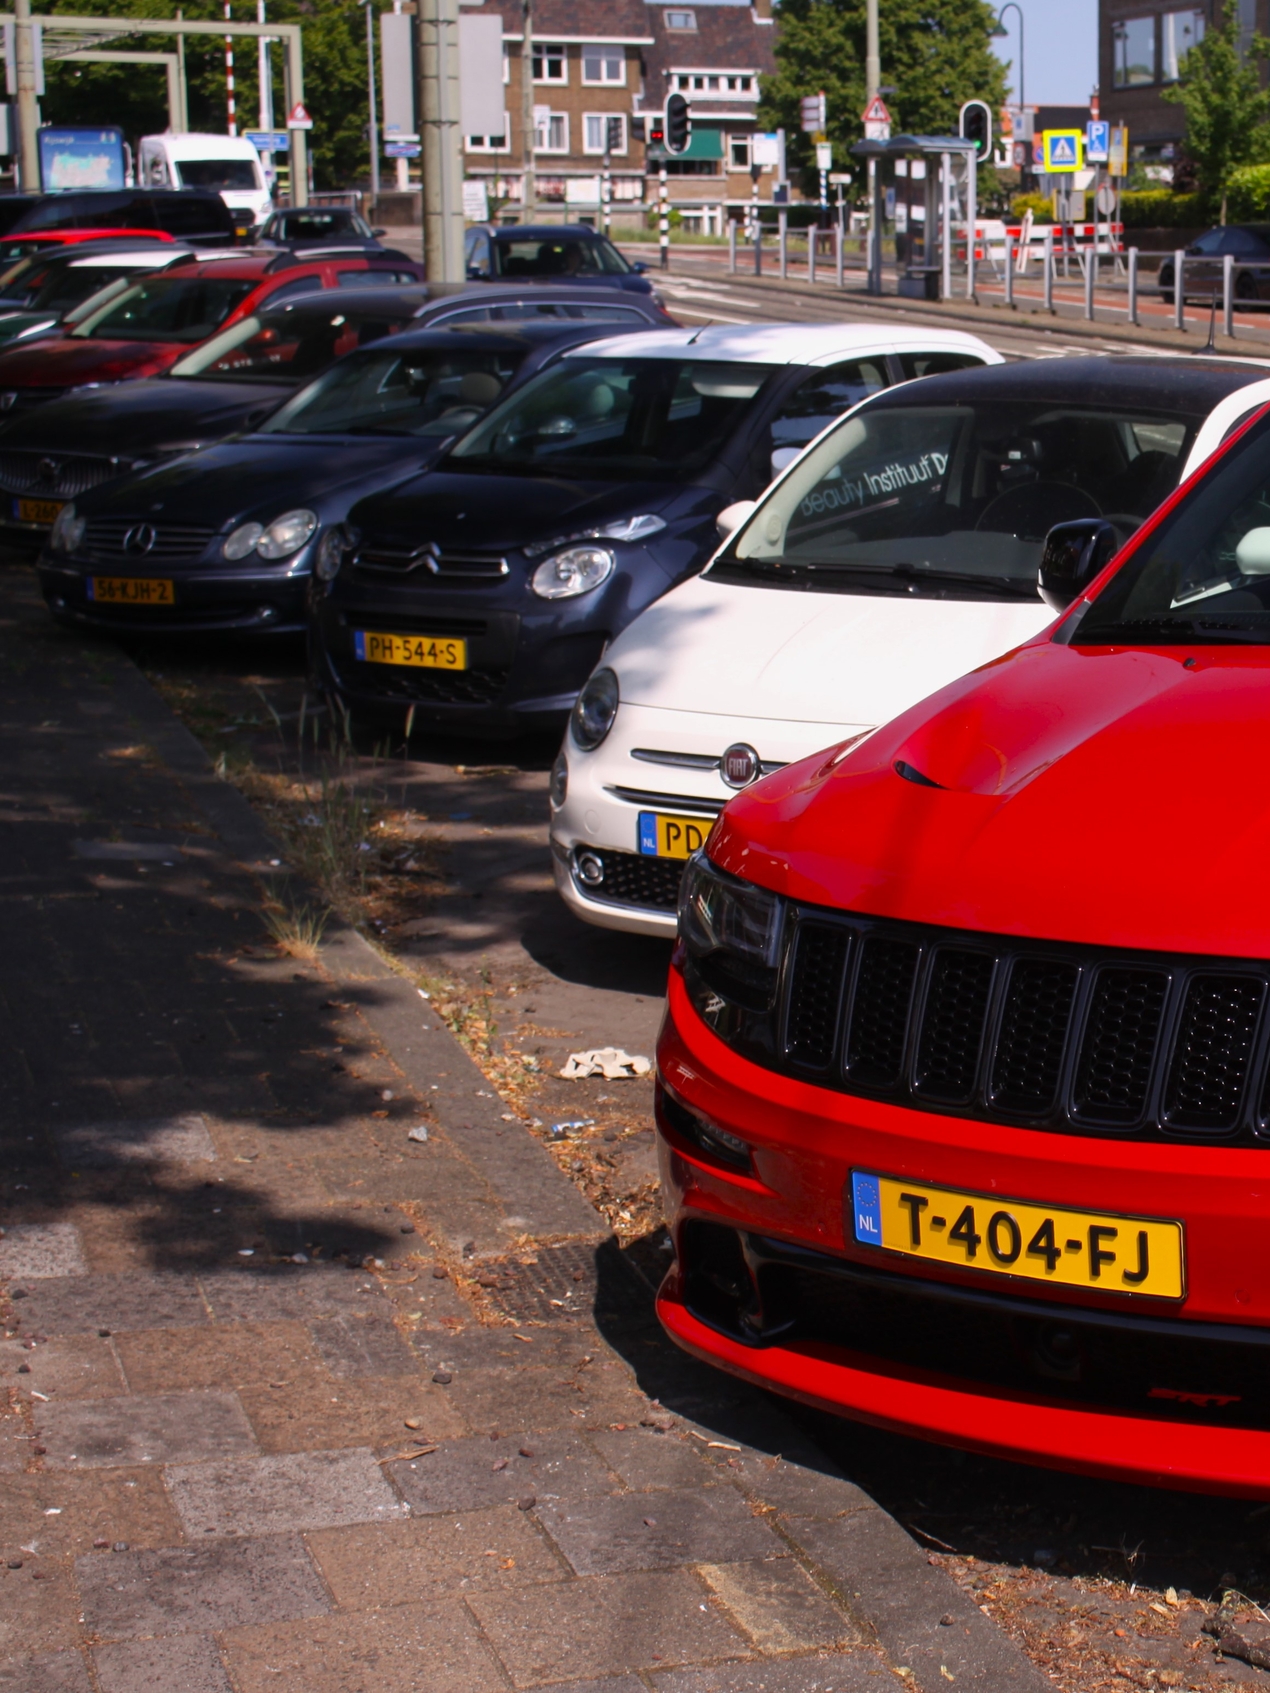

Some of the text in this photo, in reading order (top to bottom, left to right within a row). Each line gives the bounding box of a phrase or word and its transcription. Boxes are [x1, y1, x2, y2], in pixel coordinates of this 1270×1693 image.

[1091, 124, 1104, 141] P
[863, 453, 932, 496] Instituut
[97, 580, 168, 600] 56-KJH-2
[369, 636, 457, 665] PH-544-S
[728, 758, 749, 777] FIAT
[643, 838, 655, 849] NL
[859, 1214, 878, 1233] NL
[900, 1192, 1150, 1283] T-404-FJ
[1145, 1387, 1243, 1408] SRT
